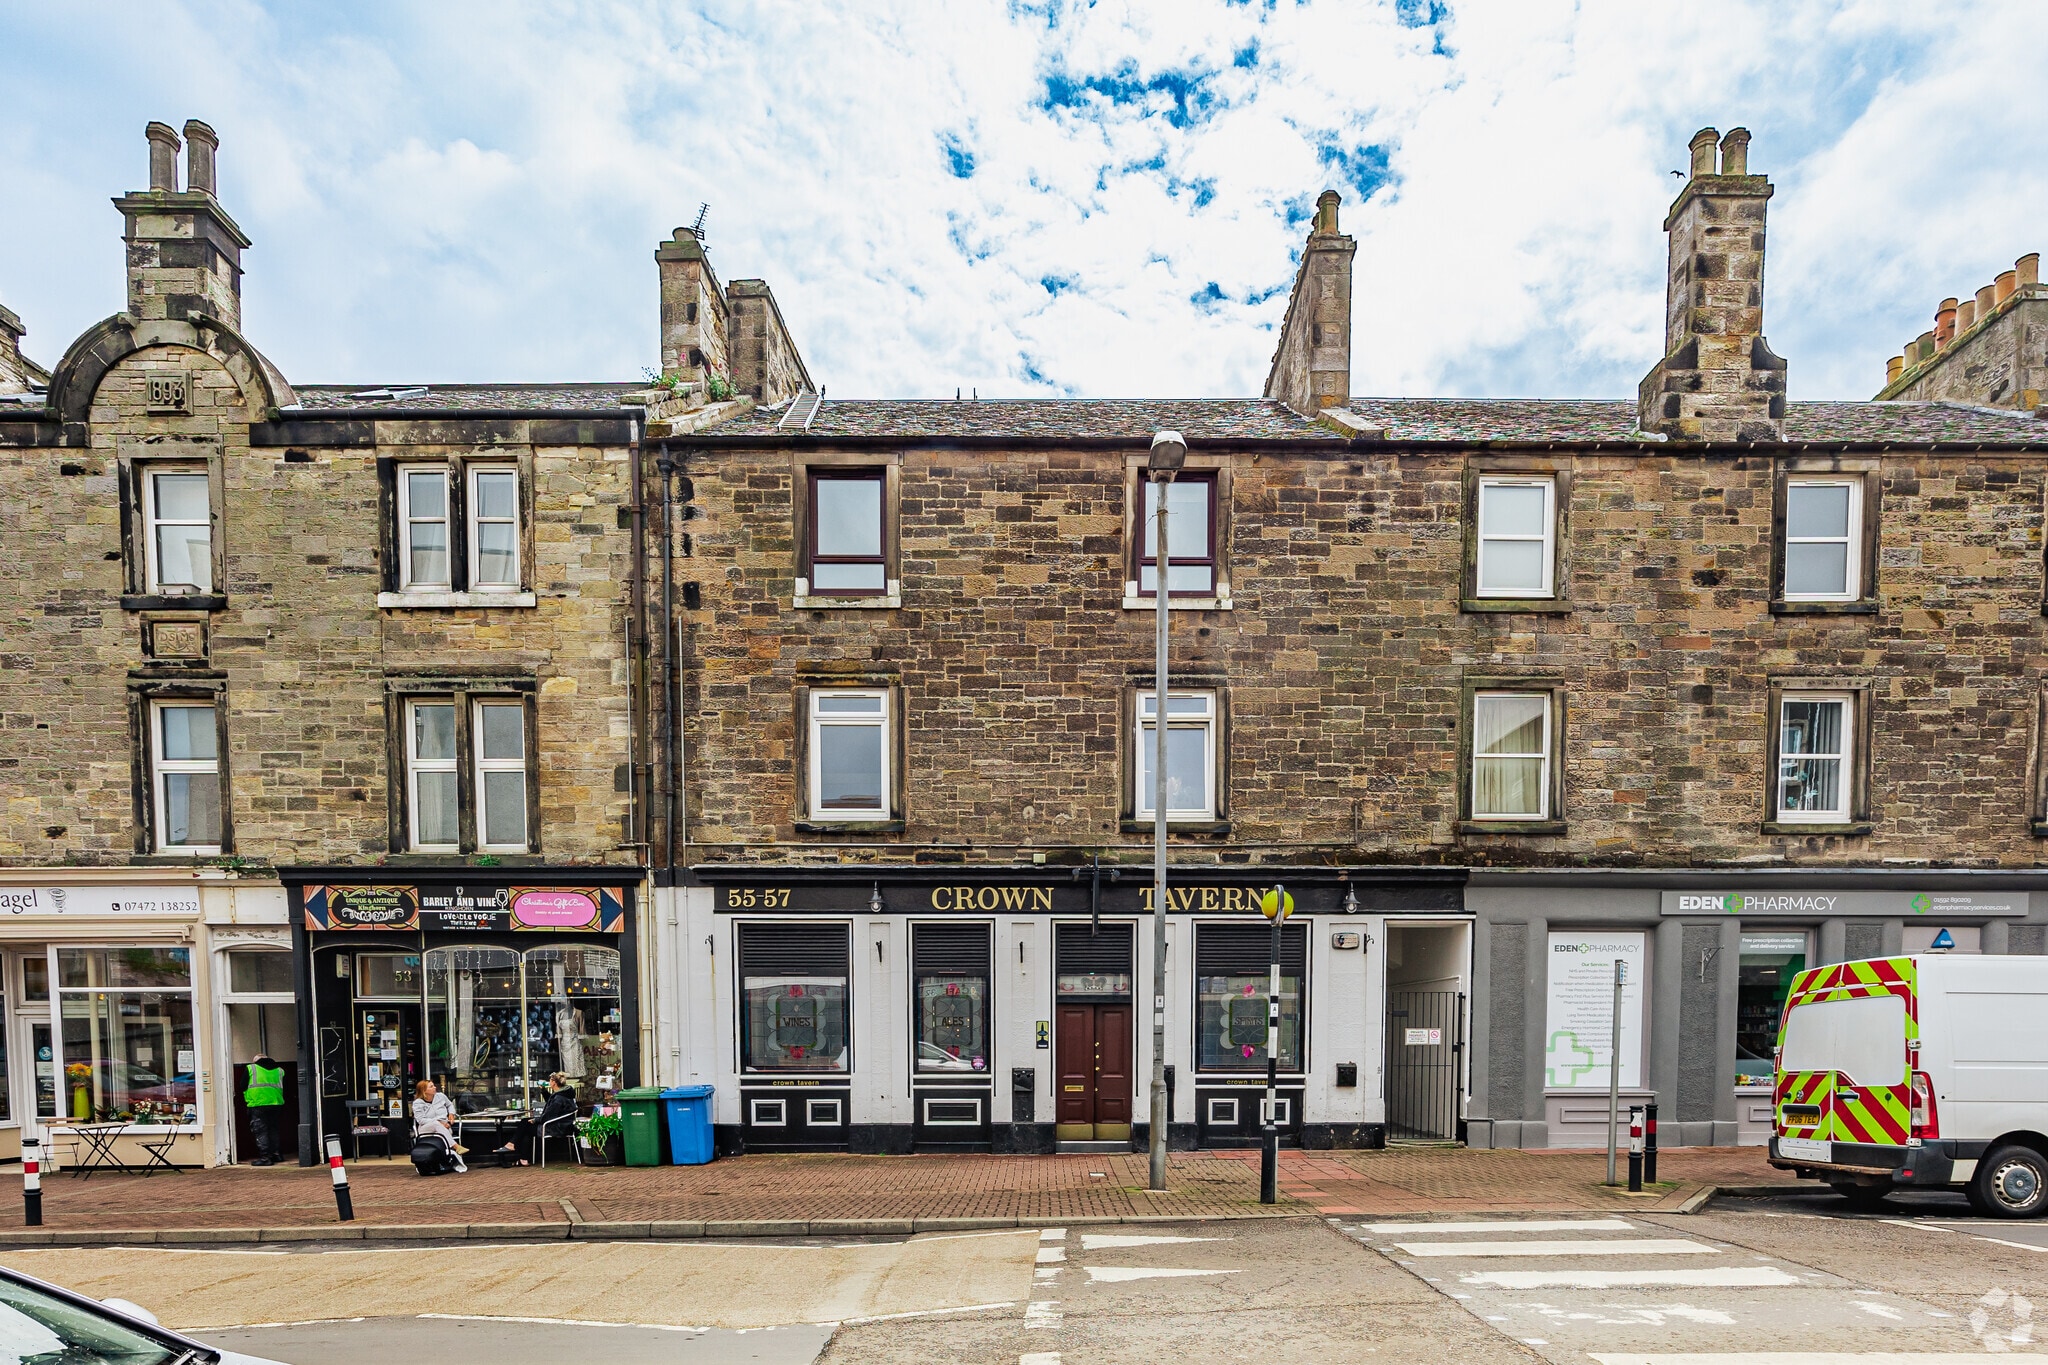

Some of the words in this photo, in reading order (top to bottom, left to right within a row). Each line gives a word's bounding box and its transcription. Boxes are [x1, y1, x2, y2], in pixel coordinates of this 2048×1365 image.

[423, 897, 453, 907] BARLEY
[457, 897, 474, 907] AND
[477, 897, 497, 907] VINE
[728, 888, 791, 908] 55-57
[931, 886, 1054, 910] CROWN
[1139, 887, 1269, 911] TAVERN
[1679, 896, 1723, 910] EDEN
[1744, 896, 1837, 910] PHARMACY
[124, 902, 156, 911] 07472
[161, 902, 197, 911] 138252
[1554, 944, 1578, 952] EDEN
[1589, 944, 1640, 953] PHARMACY
[394, 970, 412, 982] 53
[783, 1017, 811, 1027] WINES
